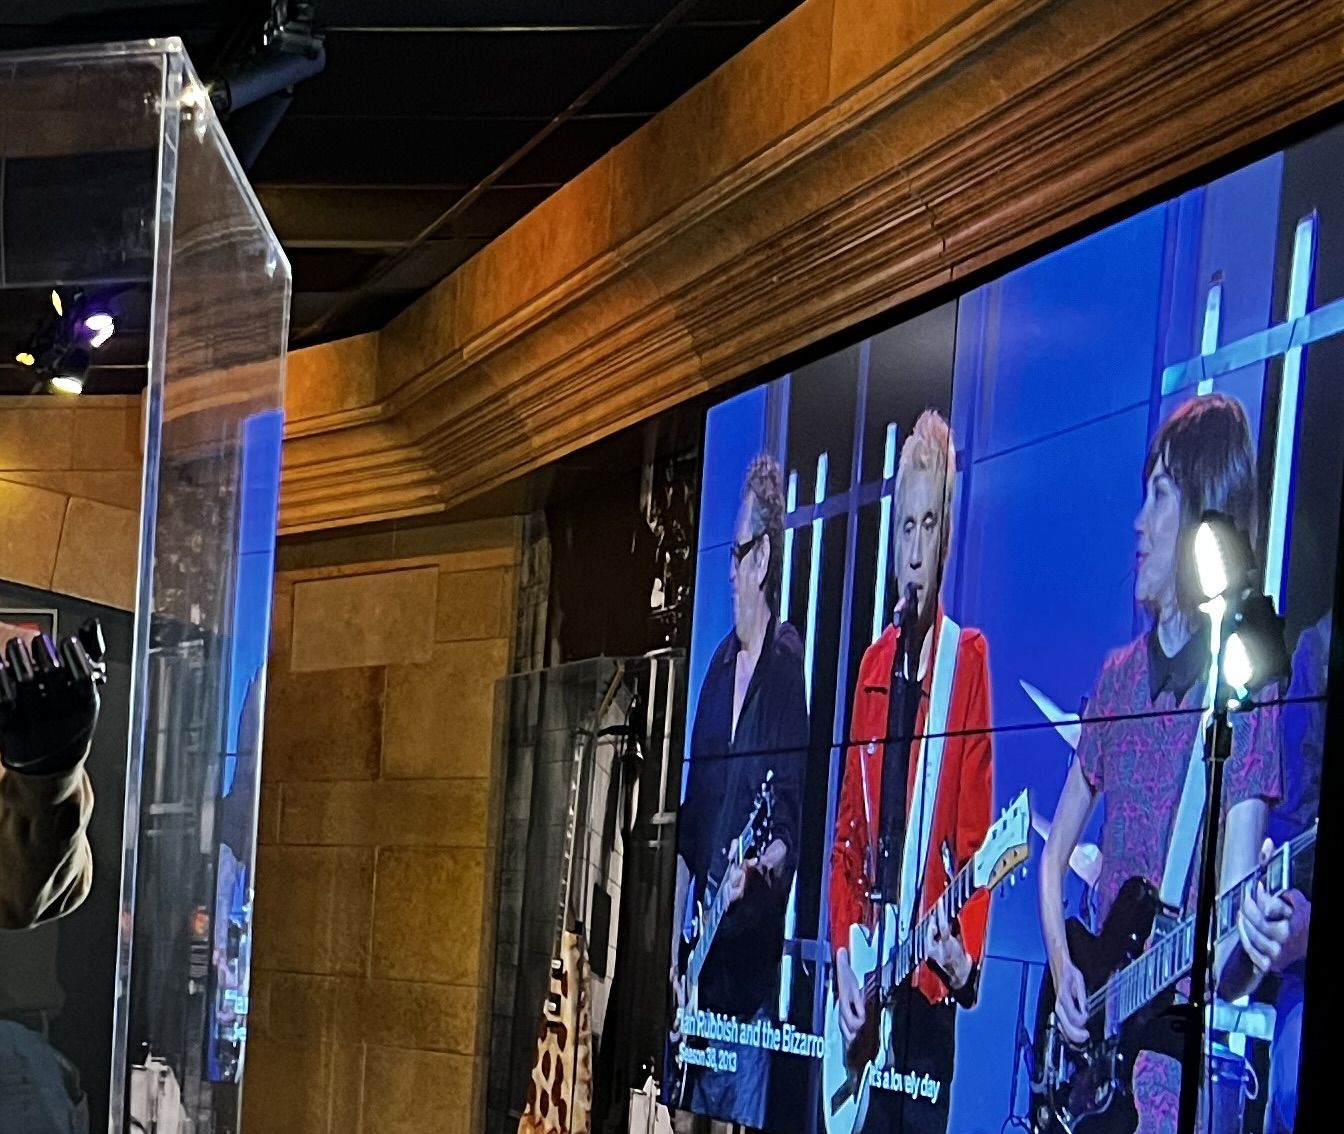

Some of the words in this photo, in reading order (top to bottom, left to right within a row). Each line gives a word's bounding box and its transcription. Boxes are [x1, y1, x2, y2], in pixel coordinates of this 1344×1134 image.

[696, 1010, 739, 1043] Rubbish
[739, 1019, 761, 1048] and
[762, 1020, 781, 1051] the
[679, 1042, 706, 1067] Season
[718, 1049, 737, 1073] 2013
[920, 1073, 941, 1104] day
